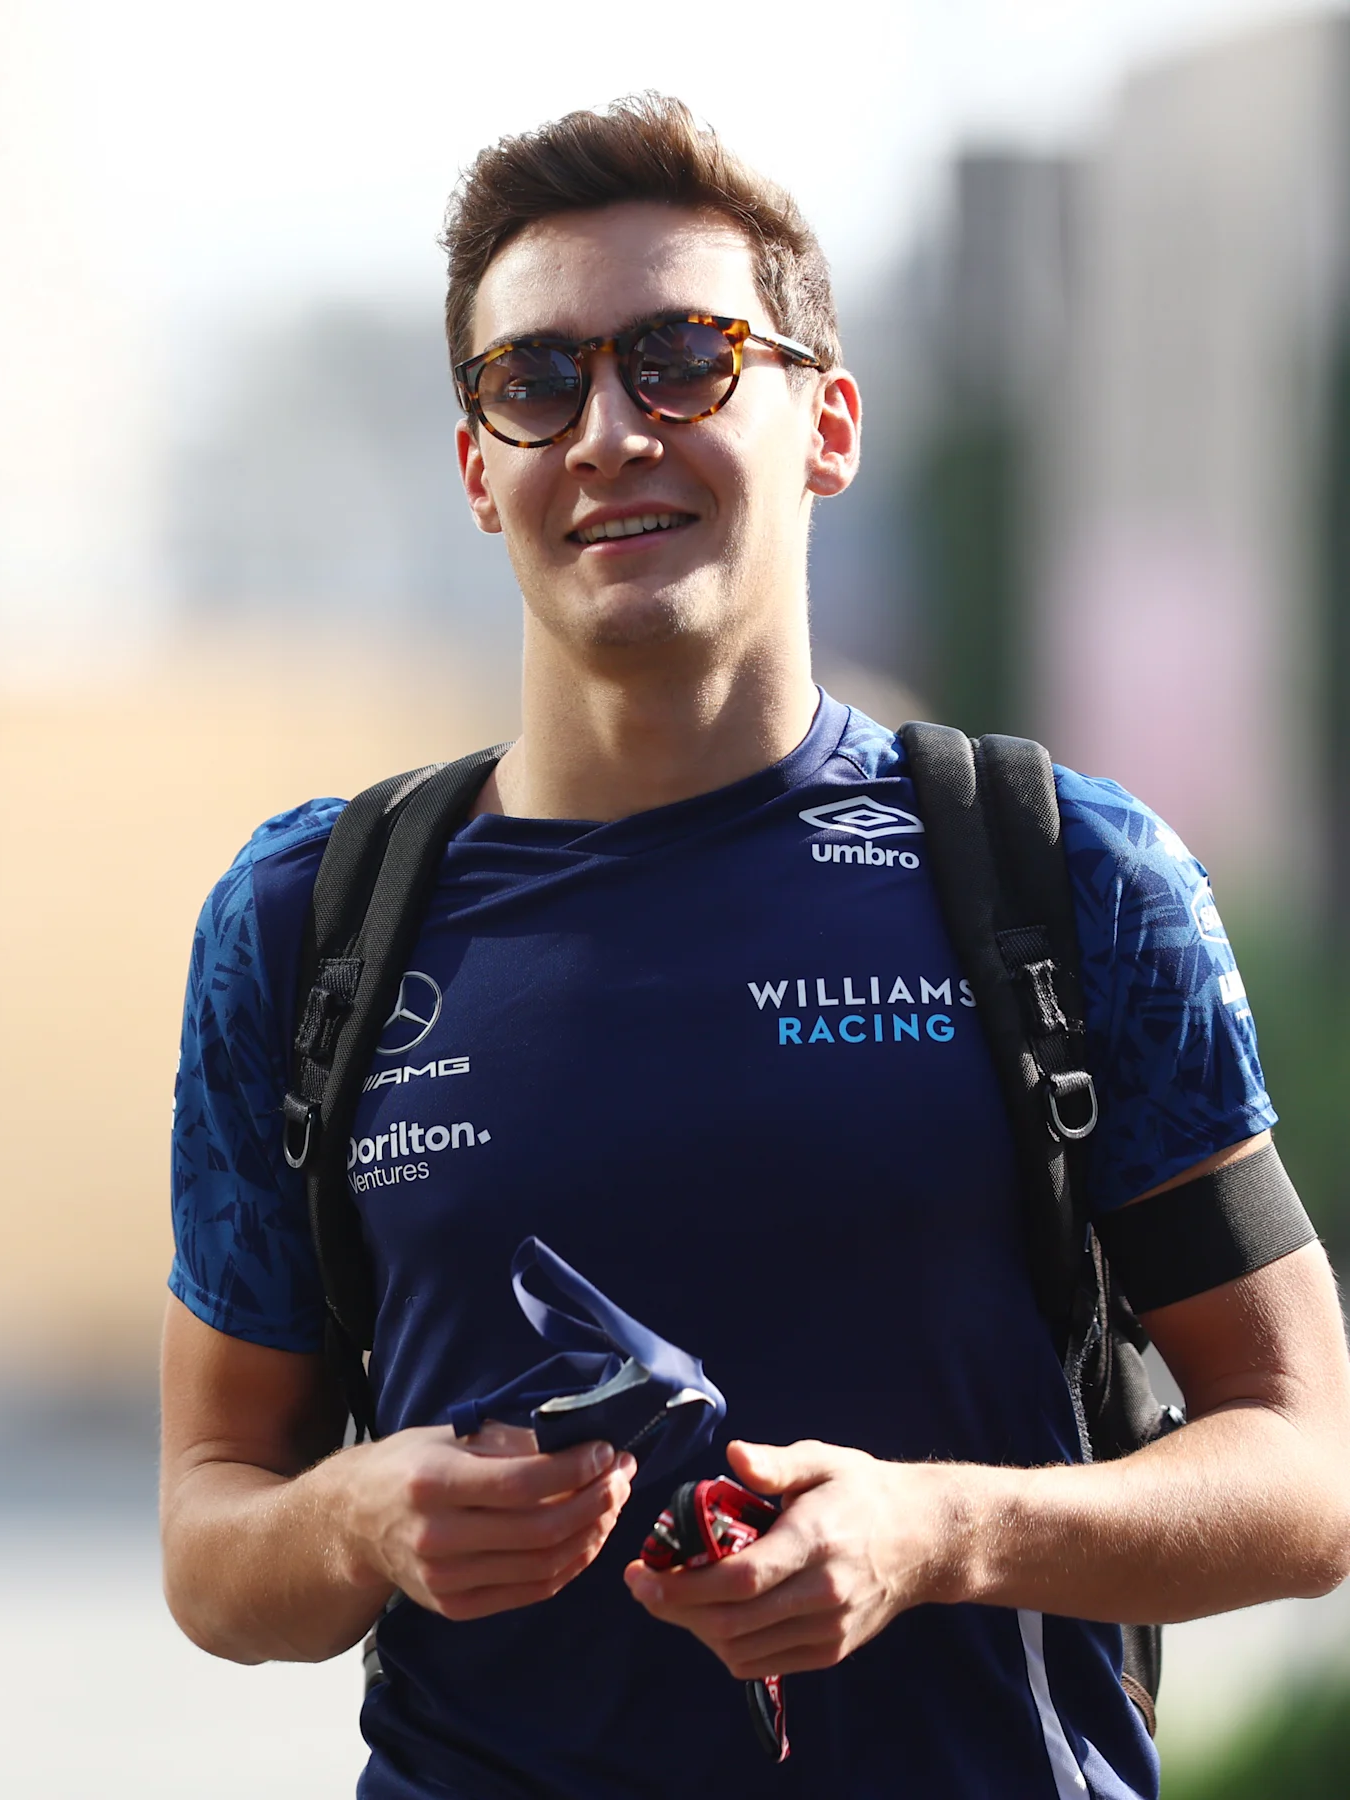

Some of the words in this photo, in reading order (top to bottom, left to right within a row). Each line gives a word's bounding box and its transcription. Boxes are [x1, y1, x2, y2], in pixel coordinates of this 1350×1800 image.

[811, 841, 920, 870] umbro
[747, 976, 978, 1011] WILLIAMS
[778, 1013, 956, 1045] RACING
[348, 1161, 430, 1194] Ventures
